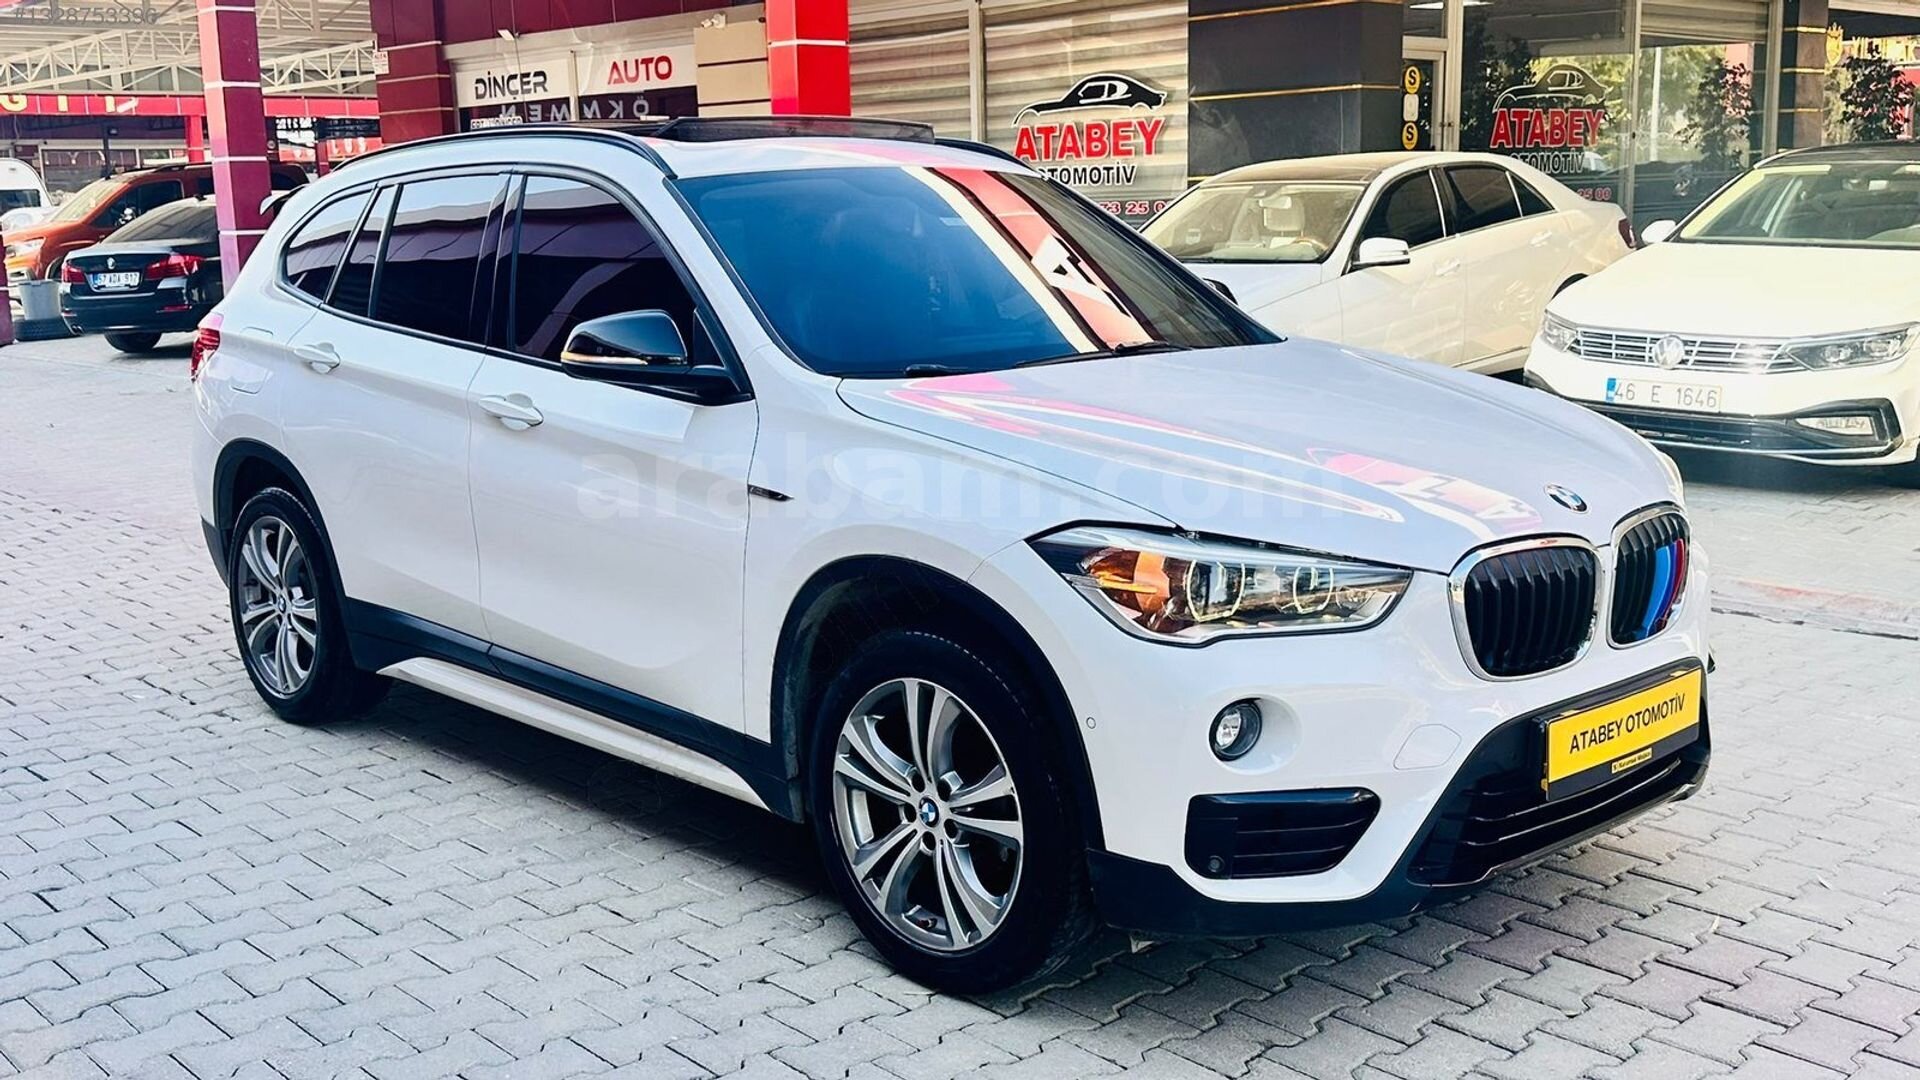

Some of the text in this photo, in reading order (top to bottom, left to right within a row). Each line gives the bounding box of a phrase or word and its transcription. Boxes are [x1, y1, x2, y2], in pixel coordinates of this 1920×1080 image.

[608, 56, 672, 85] AUTO
[475, 71, 548, 100] DİNÇER
[1012, 116, 1166, 162] ATABEY
[1490, 107, 1605, 148] ATABEY
[1125, 201, 1149, 215] 25
[1615, 383, 1717, 408] 46 E 1646
[1569, 692, 1685, 755] ATABEY OTOMOTİV
